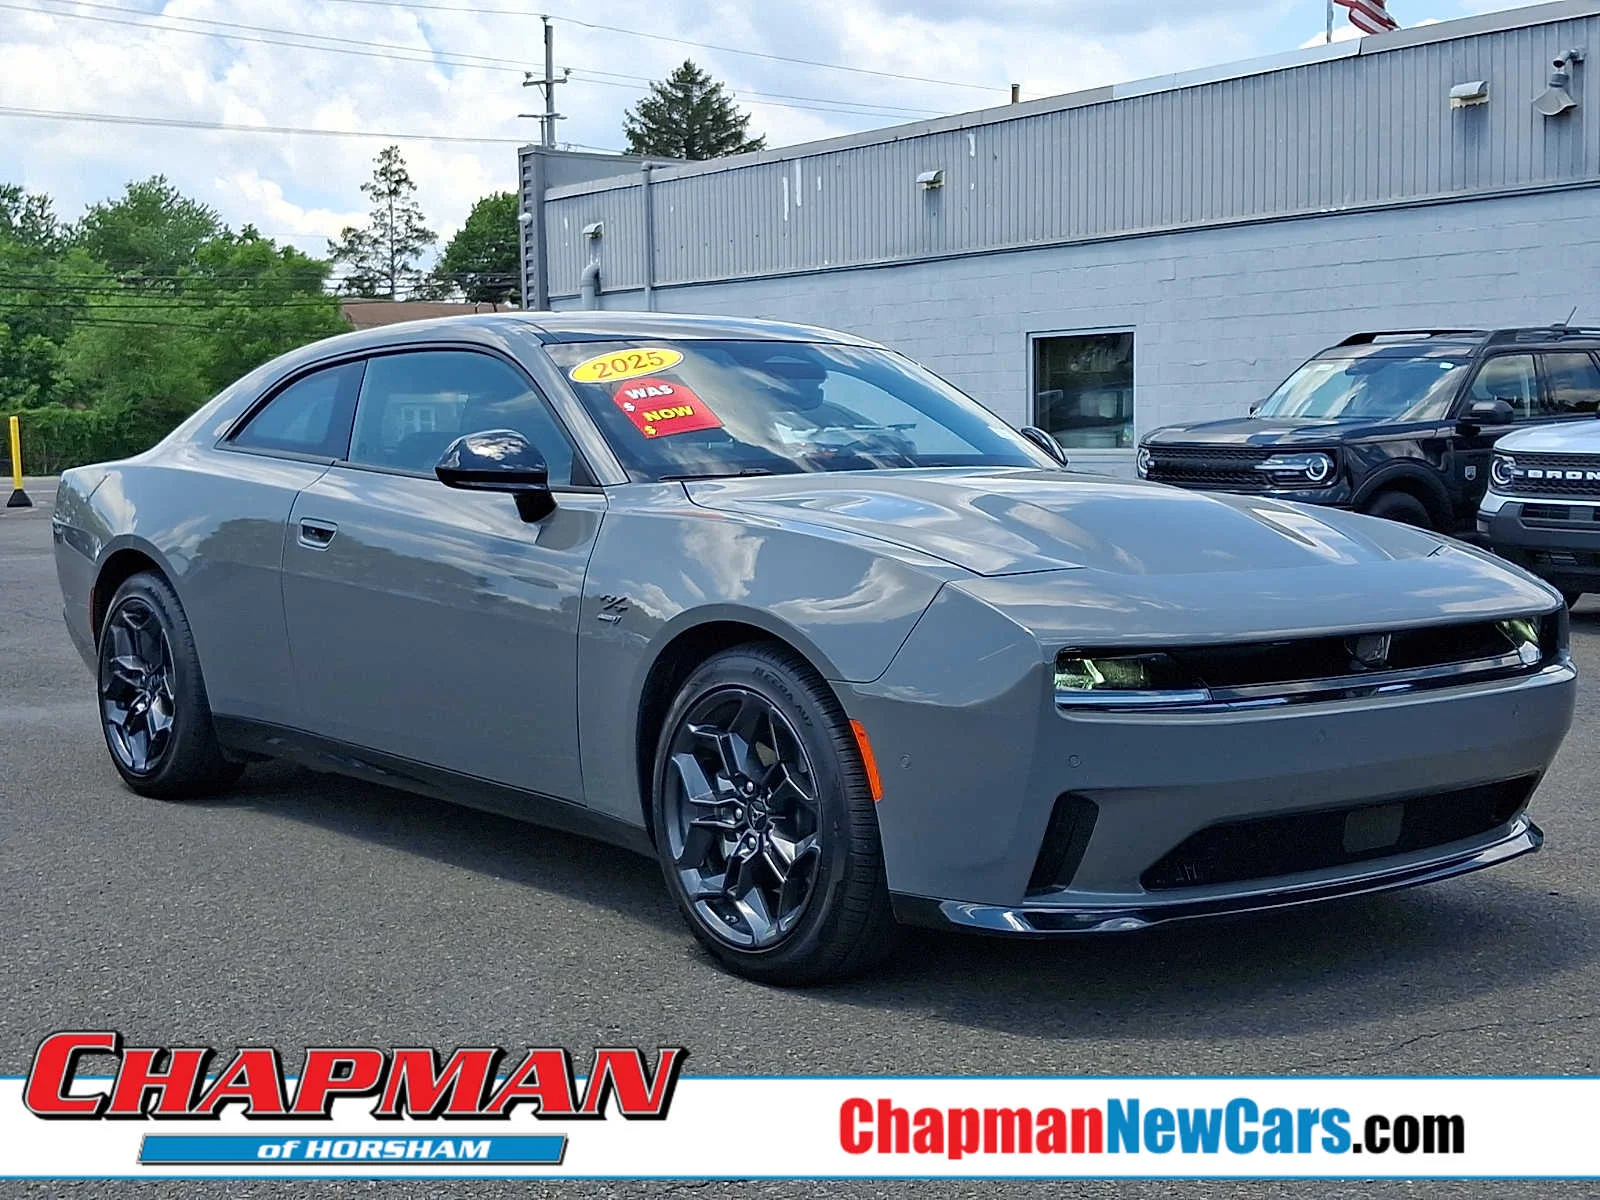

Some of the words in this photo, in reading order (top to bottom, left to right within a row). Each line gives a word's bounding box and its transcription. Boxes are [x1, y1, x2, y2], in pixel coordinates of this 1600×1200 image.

[593, 352, 664, 378] 2025
[625, 385, 674, 399] WAS
[643, 406, 694, 422] NOW
[1527, 469, 1600, 480] BRON
